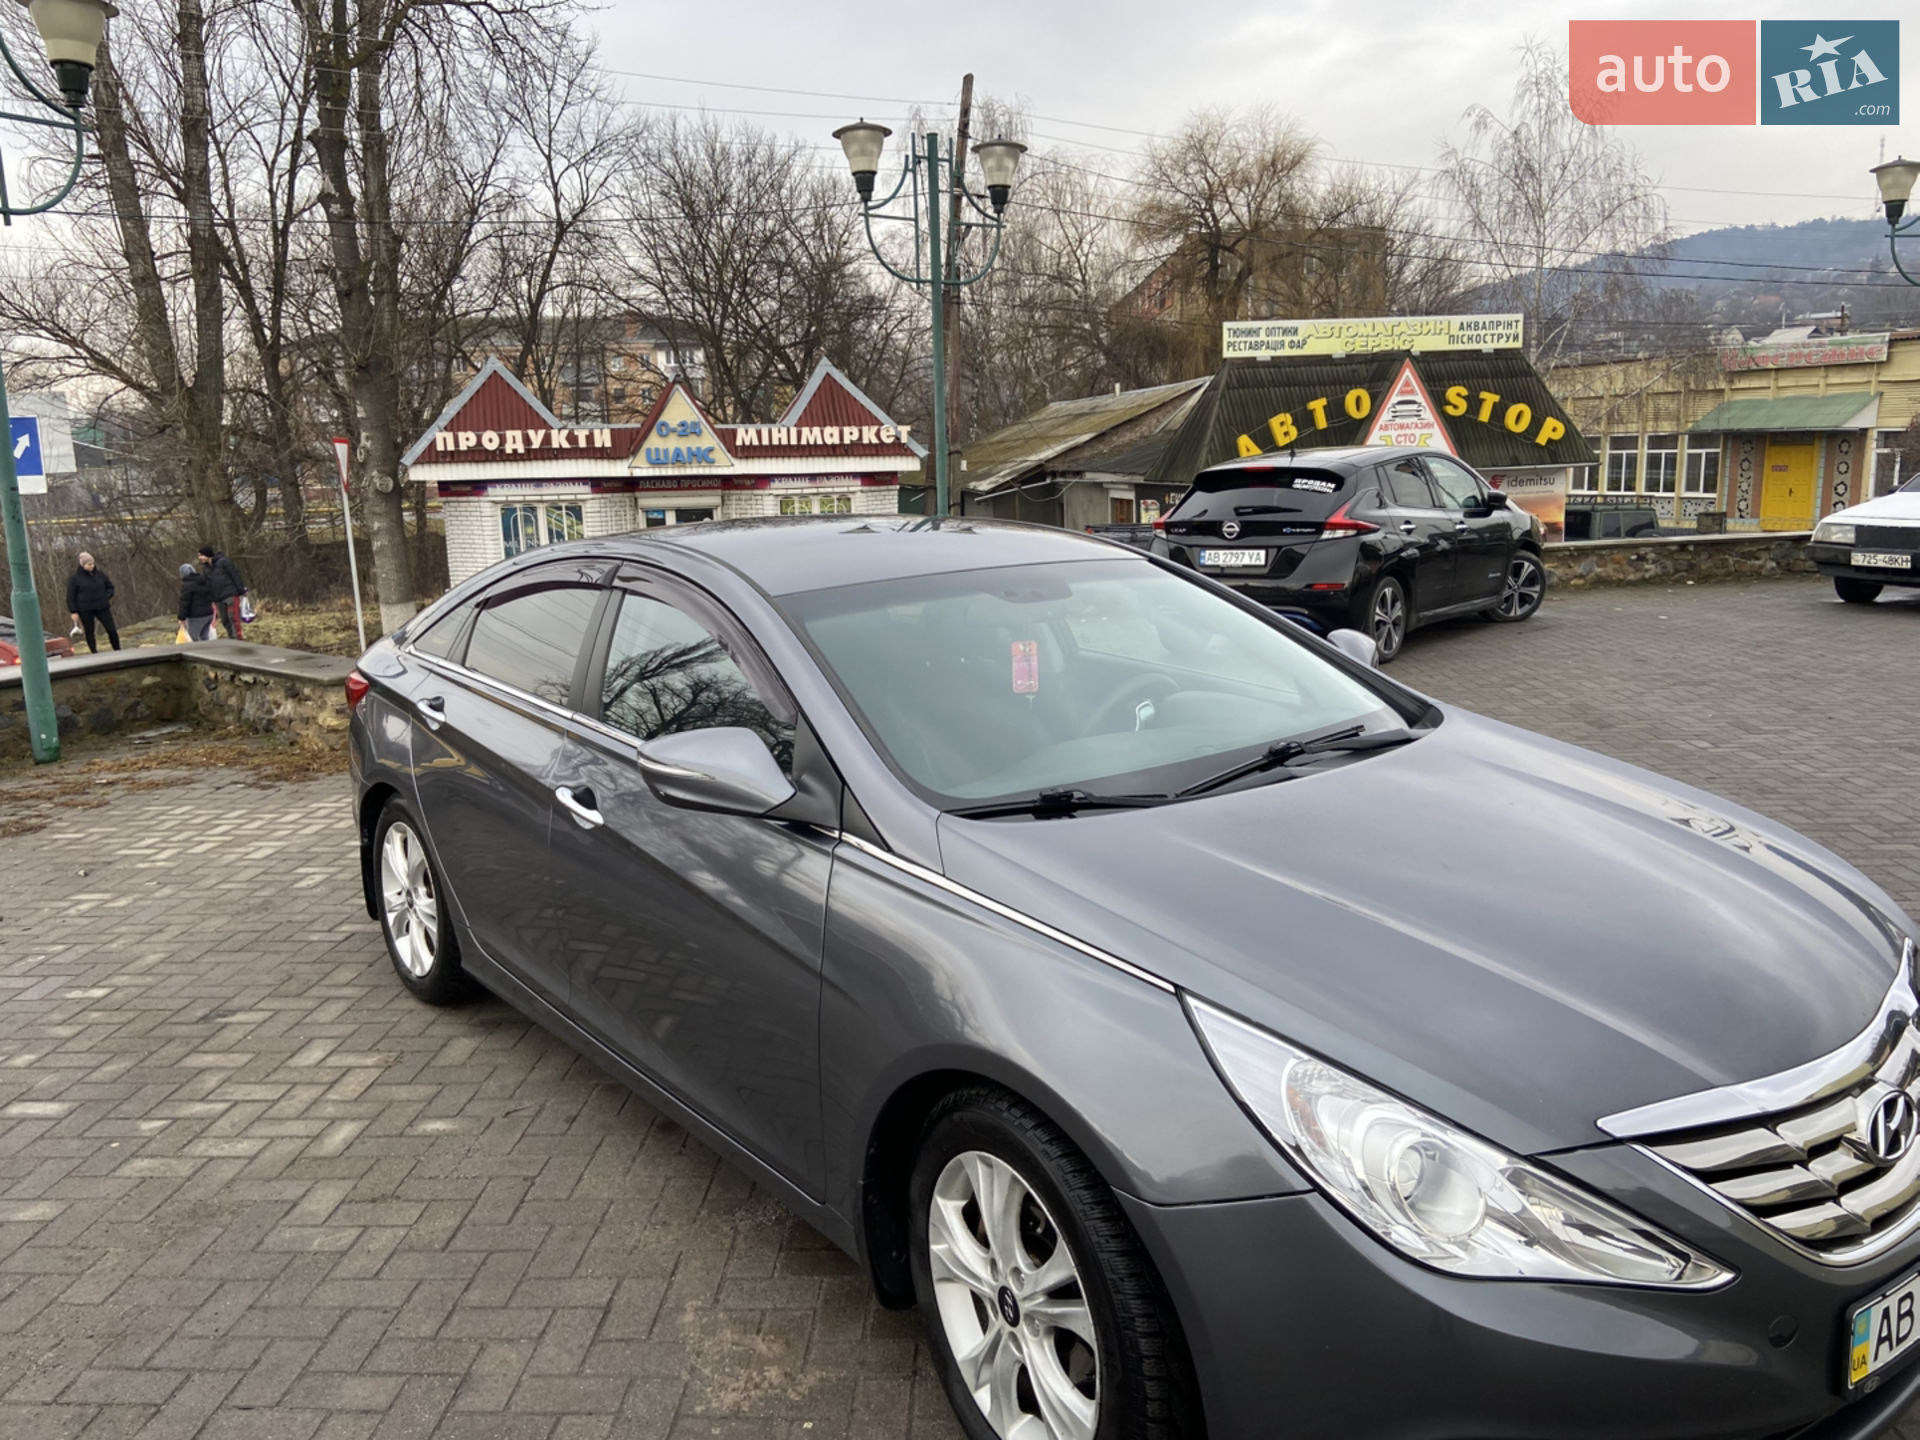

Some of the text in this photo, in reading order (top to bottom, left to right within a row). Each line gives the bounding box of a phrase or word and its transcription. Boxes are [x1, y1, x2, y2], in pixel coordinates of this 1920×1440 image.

[1265, 326, 1299, 338] ОПТИКИ
[1304, 319, 1450, 339] АВТОМАГАЗИН
[1458, 319, 1521, 332] АКВАПРІНТ
[1340, 336, 1414, 353] СЕРВІС
[1448, 331, 1520, 345] ПІСКОСТРУЙ
[1227, 339, 1308, 352] РЕСТАВРАЦІЯ ФАР
[656, 420, 703, 437] 0-24
[1236, 386, 1566, 458] АВТО STOP
[1378, 422, 1435, 431] АВТОМАГАЗИН
[435, 428, 613, 454] ПРОДУКТИ
[1395, 433, 1417, 444] СТО
[645, 446, 716, 465] ШАНС
[639, 479, 678, 489] ЛАСКАВО
[1507, 475, 1556, 488] idemitsu
[1206, 552, 1262, 563] AB 2797 YA
[1872, 1291, 1915, 1363] AB
[1852, 1353, 1868, 1372] UA
